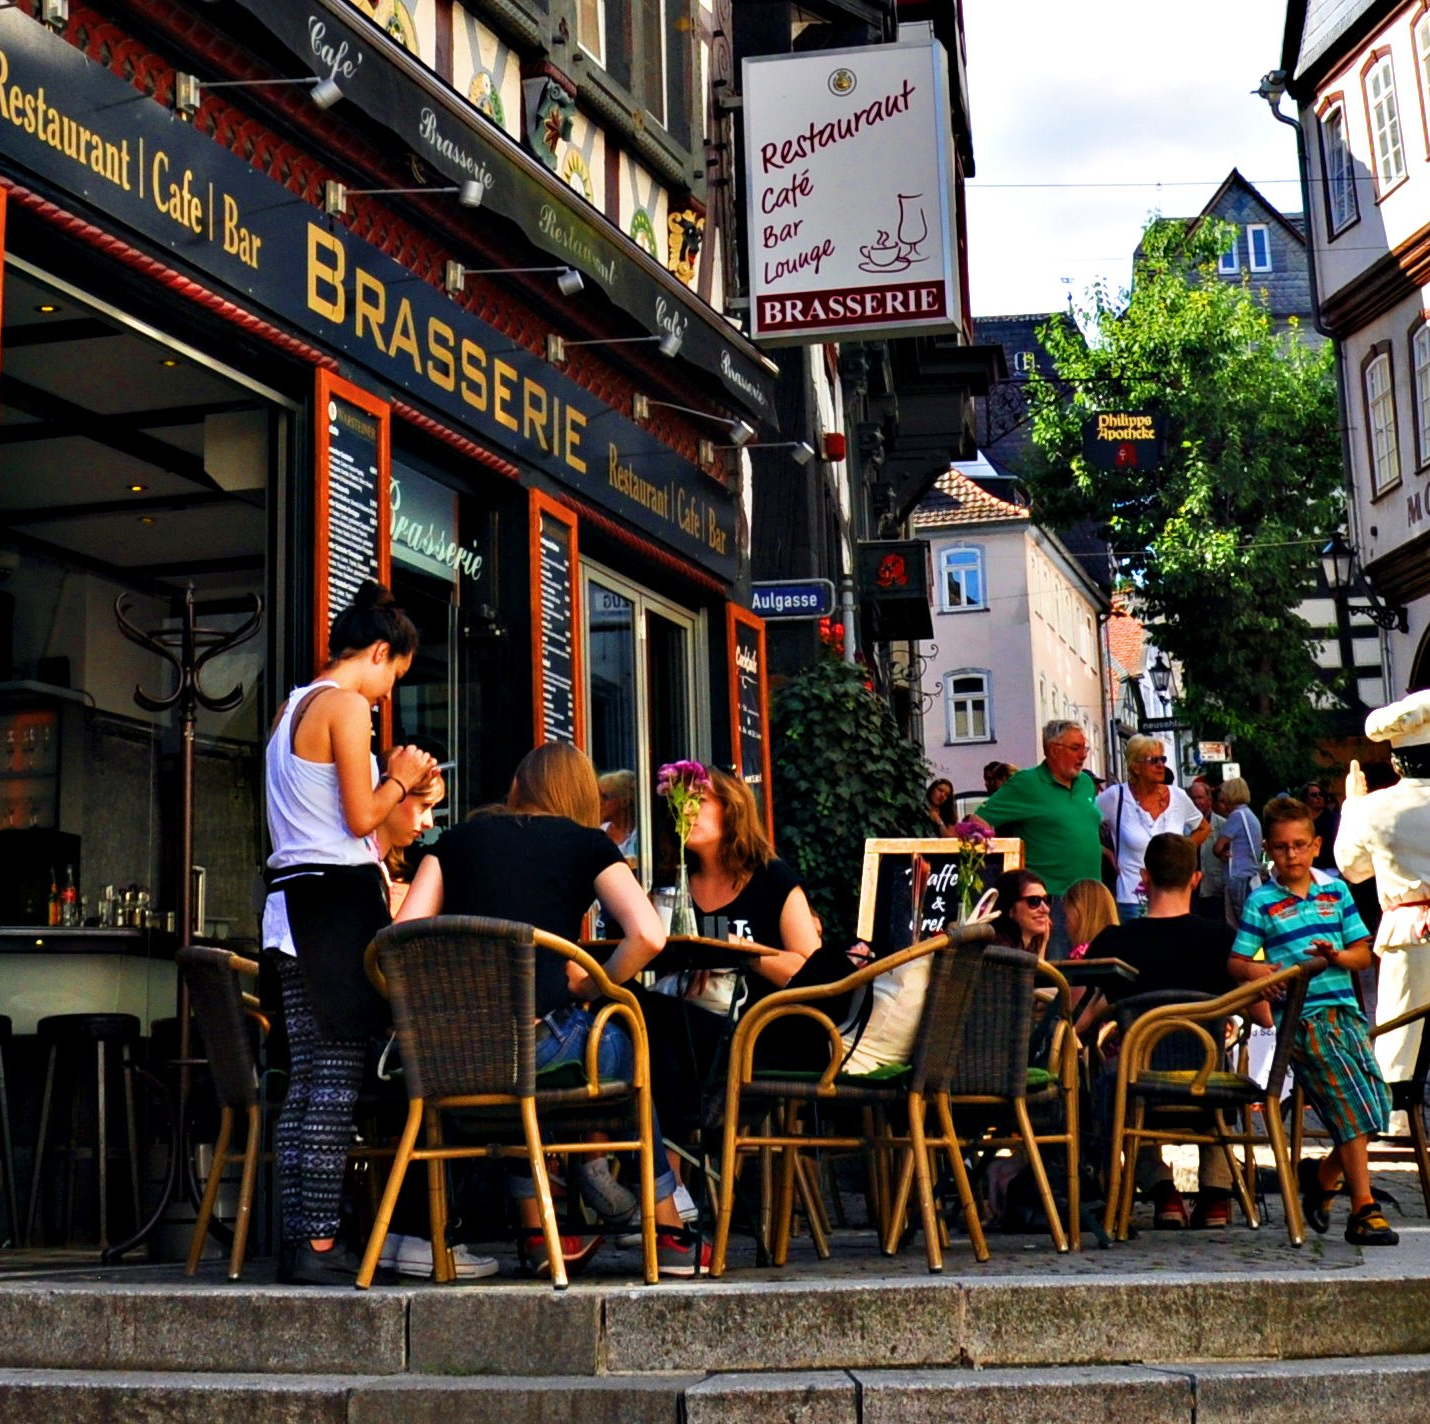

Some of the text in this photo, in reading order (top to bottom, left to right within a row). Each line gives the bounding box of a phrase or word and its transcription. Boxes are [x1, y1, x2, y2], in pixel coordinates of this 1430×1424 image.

[419, 107, 495, 190] Brasserie
[761, 79, 916, 174] Restaurant
[152, 150, 203, 234] Cafe
[223, 192, 262, 269] Bar
[761, 169, 815, 215] Café
[539, 204, 616, 286] Restaurant
[763, 219, 804, 248] Bar
[764, 238, 836, 285] Lounge
[763, 287, 940, 324] BRASSERIE
[305, 221, 588, 474] BRASSERIE
[1097, 428, 1155, 441] Apotheke
[1098, 413, 1153, 427] Philipps
[608, 442, 726, 555] Restaurant Cafe Bar
[752, 591, 818, 614] Aulgasse
[905, 864, 974, 892] affe
[932, 896, 946, 912] &
